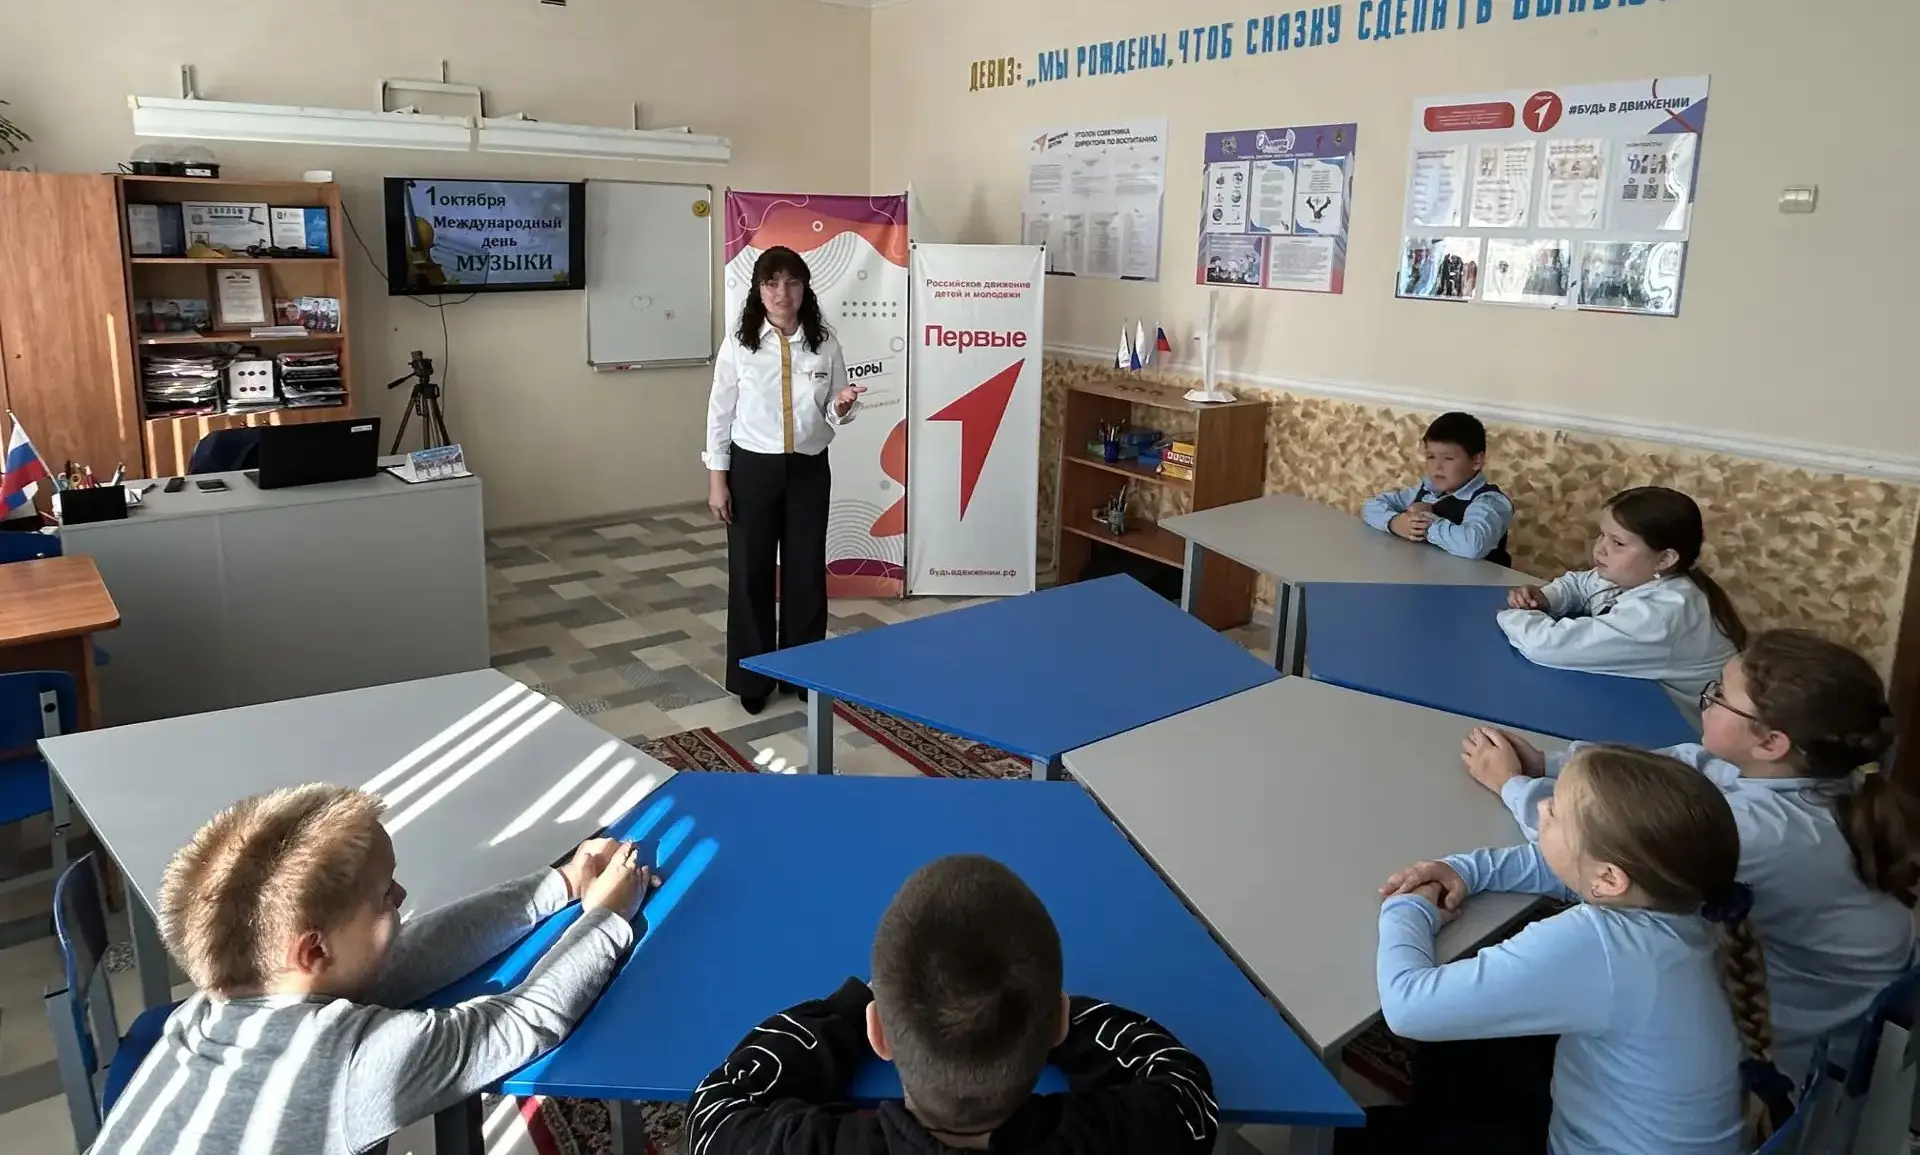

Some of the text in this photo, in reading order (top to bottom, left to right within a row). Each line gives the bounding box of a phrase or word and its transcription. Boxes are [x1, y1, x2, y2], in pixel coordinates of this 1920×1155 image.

[969, 57, 1022, 91] ДЕВИЗ:
[1077, 33, 1173, 78] РОЖДЕНЫ,
[1179, 22, 1233, 63] ЧТОБ
[1247, 5, 1341, 54] СКАЗКУ
[1568, 97, 1690, 115] #БУДЬ В ДВИЖЕНИИ
[1097, 128, 1130, 137] СОВЕТНИКА
[1075, 135, 1158, 147] ДИРЕКТОРА ПО ВОСПИТАНИЮ
[425, 186, 506, 209] 1 октября
[434, 216, 562, 231] Международный
[481, 236, 517, 249] день
[456, 254, 553, 272] МУЗЫКИ
[926, 279, 1031, 289] Российское движение
[935, 290, 962, 298] детей
[973, 291, 1021, 299] молодежи
[925, 325, 1027, 354] Первые
